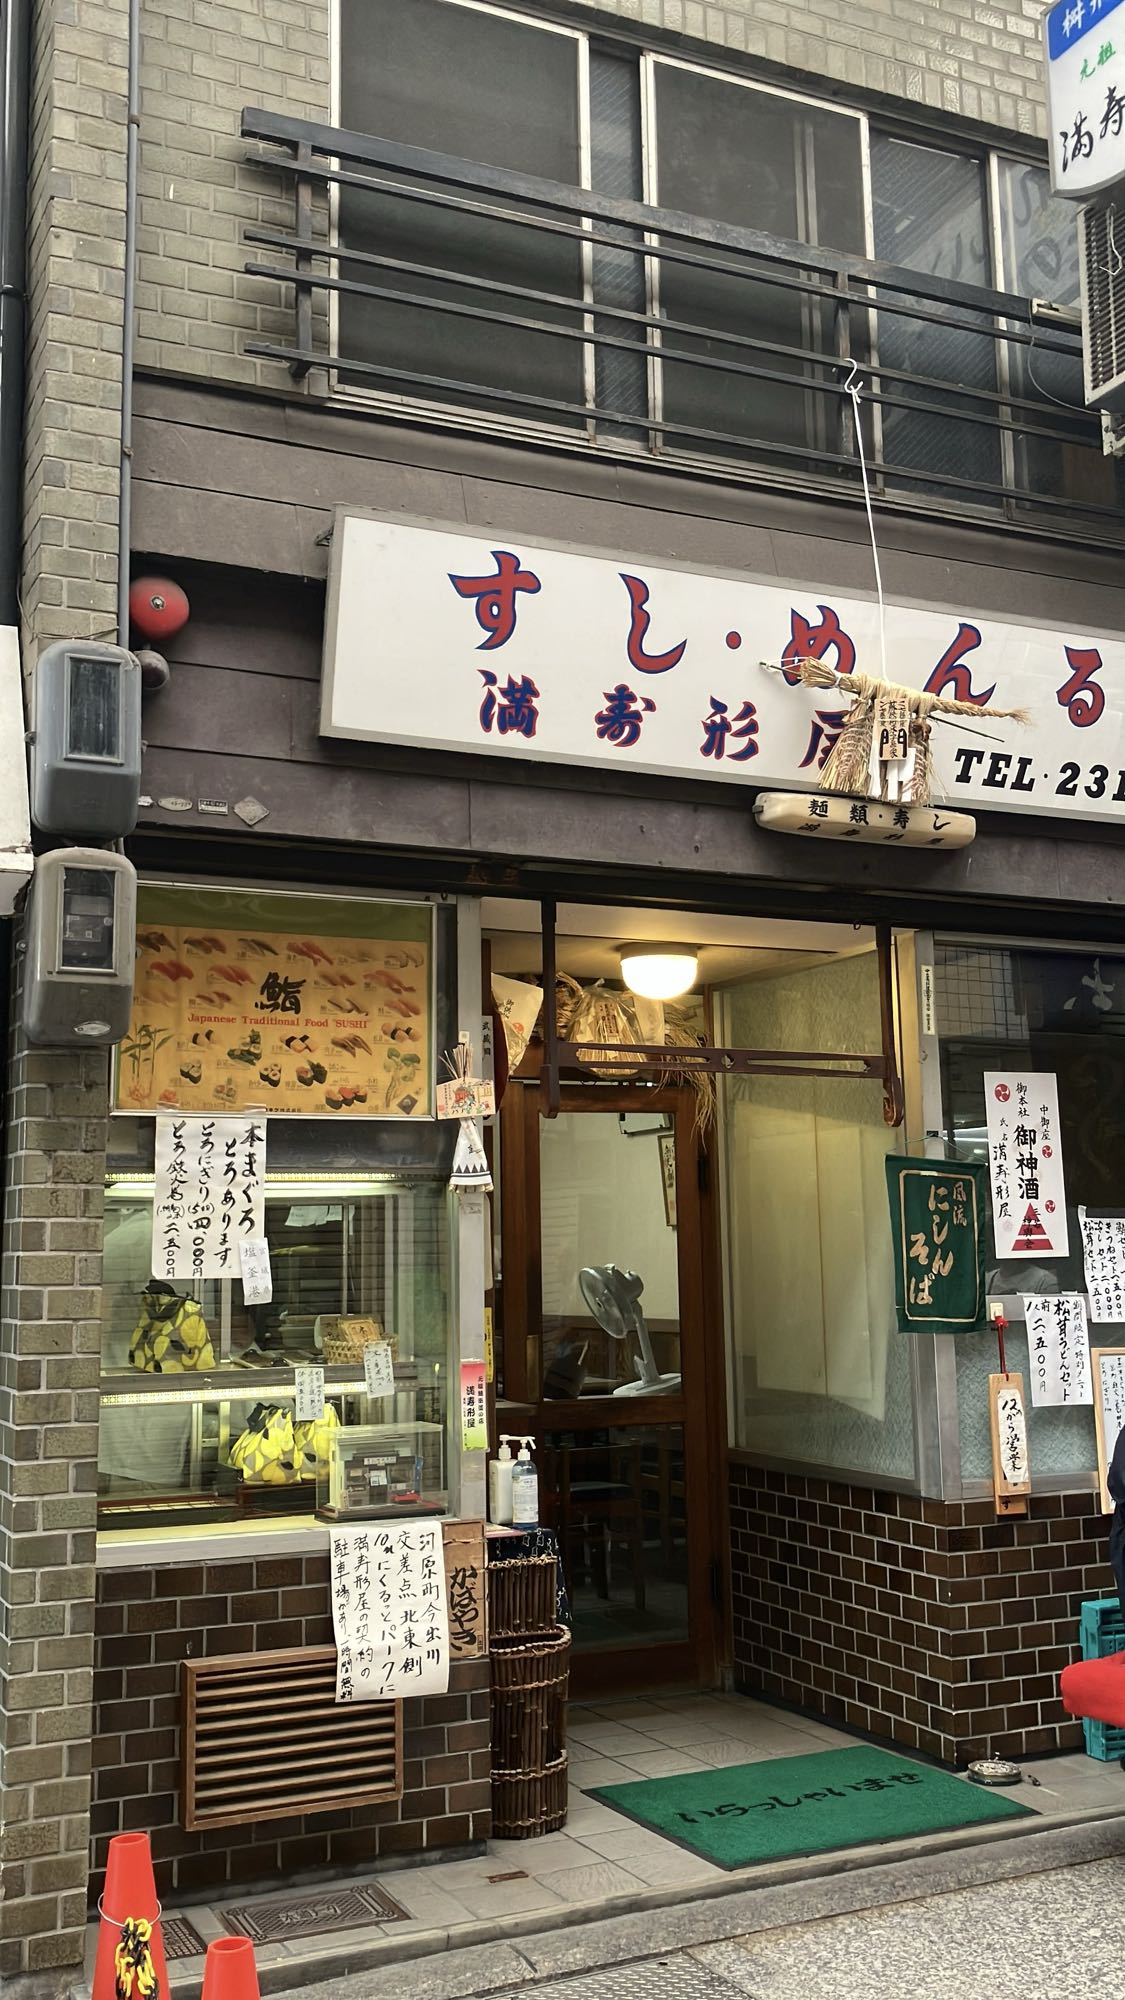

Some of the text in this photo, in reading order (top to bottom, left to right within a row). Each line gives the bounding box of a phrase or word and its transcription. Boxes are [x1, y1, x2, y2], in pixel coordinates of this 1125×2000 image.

[1080, 41, 1116, 82] 元祖
[254, 971, 307, 1014] 鮨
[187, 1013, 368, 1029] Japanese Traditional Food SUSHI
[1015, 1081, 1030, 1118] 御本社
[1039, 1104, 1051, 1141] 中御座
[238, 1121, 265, 1235] 本まぐろ
[1013, 1123, 1040, 1201] 御神酒
[952, 1180, 967, 1227] 風流
[396, 1530, 423, 1678] 交差点 北東側
[419, 1531, 442, 1666] 河原町今出川
[674, 1771, 923, 1824] いらっしゃいませ
